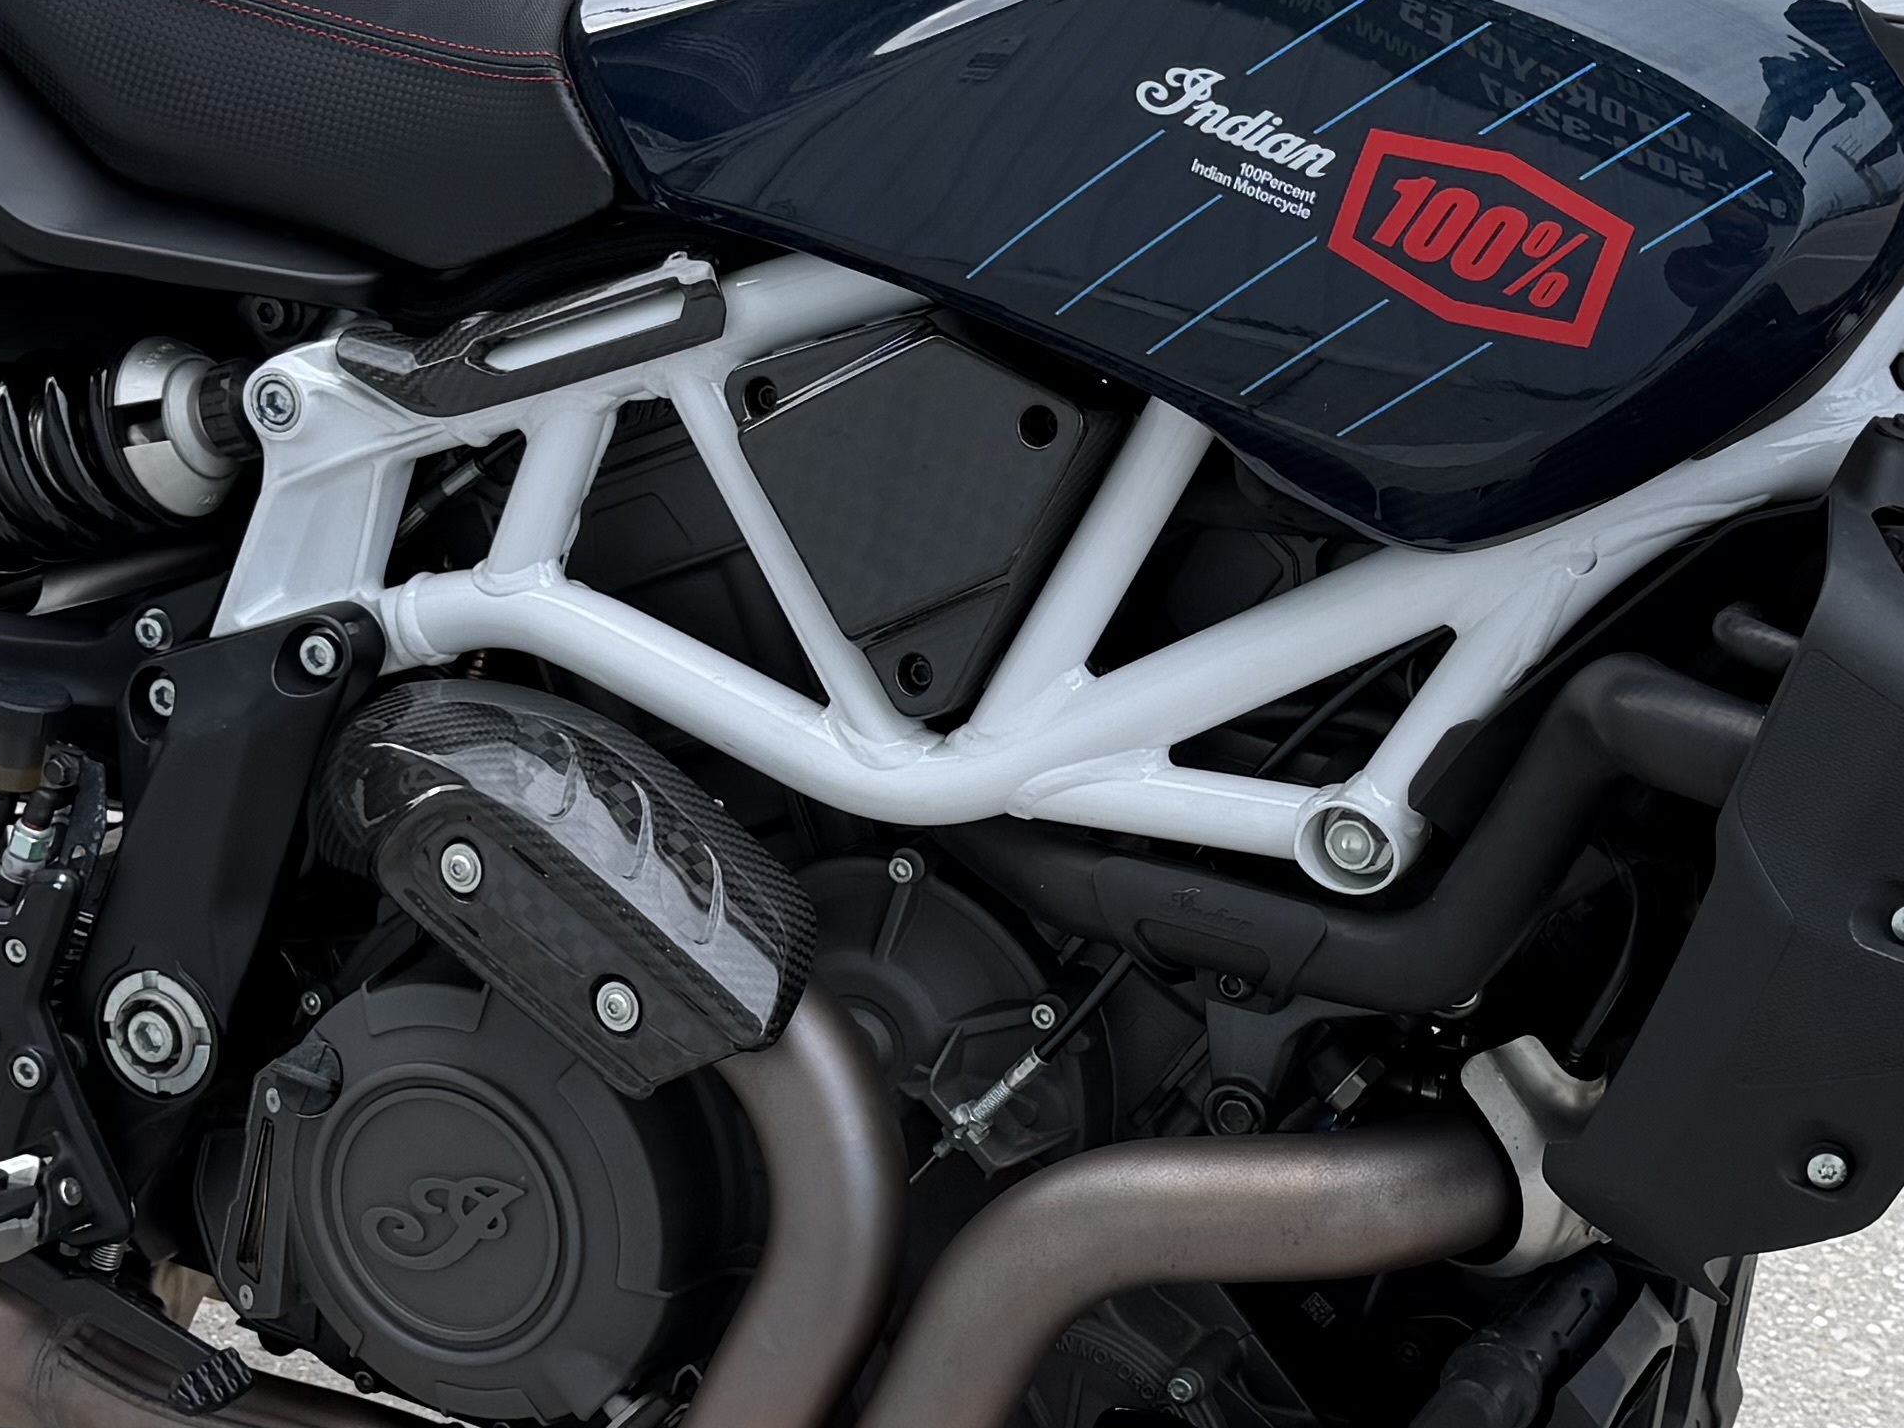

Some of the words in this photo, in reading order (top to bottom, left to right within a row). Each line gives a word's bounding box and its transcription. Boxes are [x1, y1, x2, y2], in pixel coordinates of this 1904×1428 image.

[1135, 66, 1337, 178] Indian
[1190, 158, 1232, 188] Indian
[1232, 175, 1312, 220] Motorcycle
[1239, 162, 1317, 205] 100Percent
[1372, 175, 1590, 310] 100%
